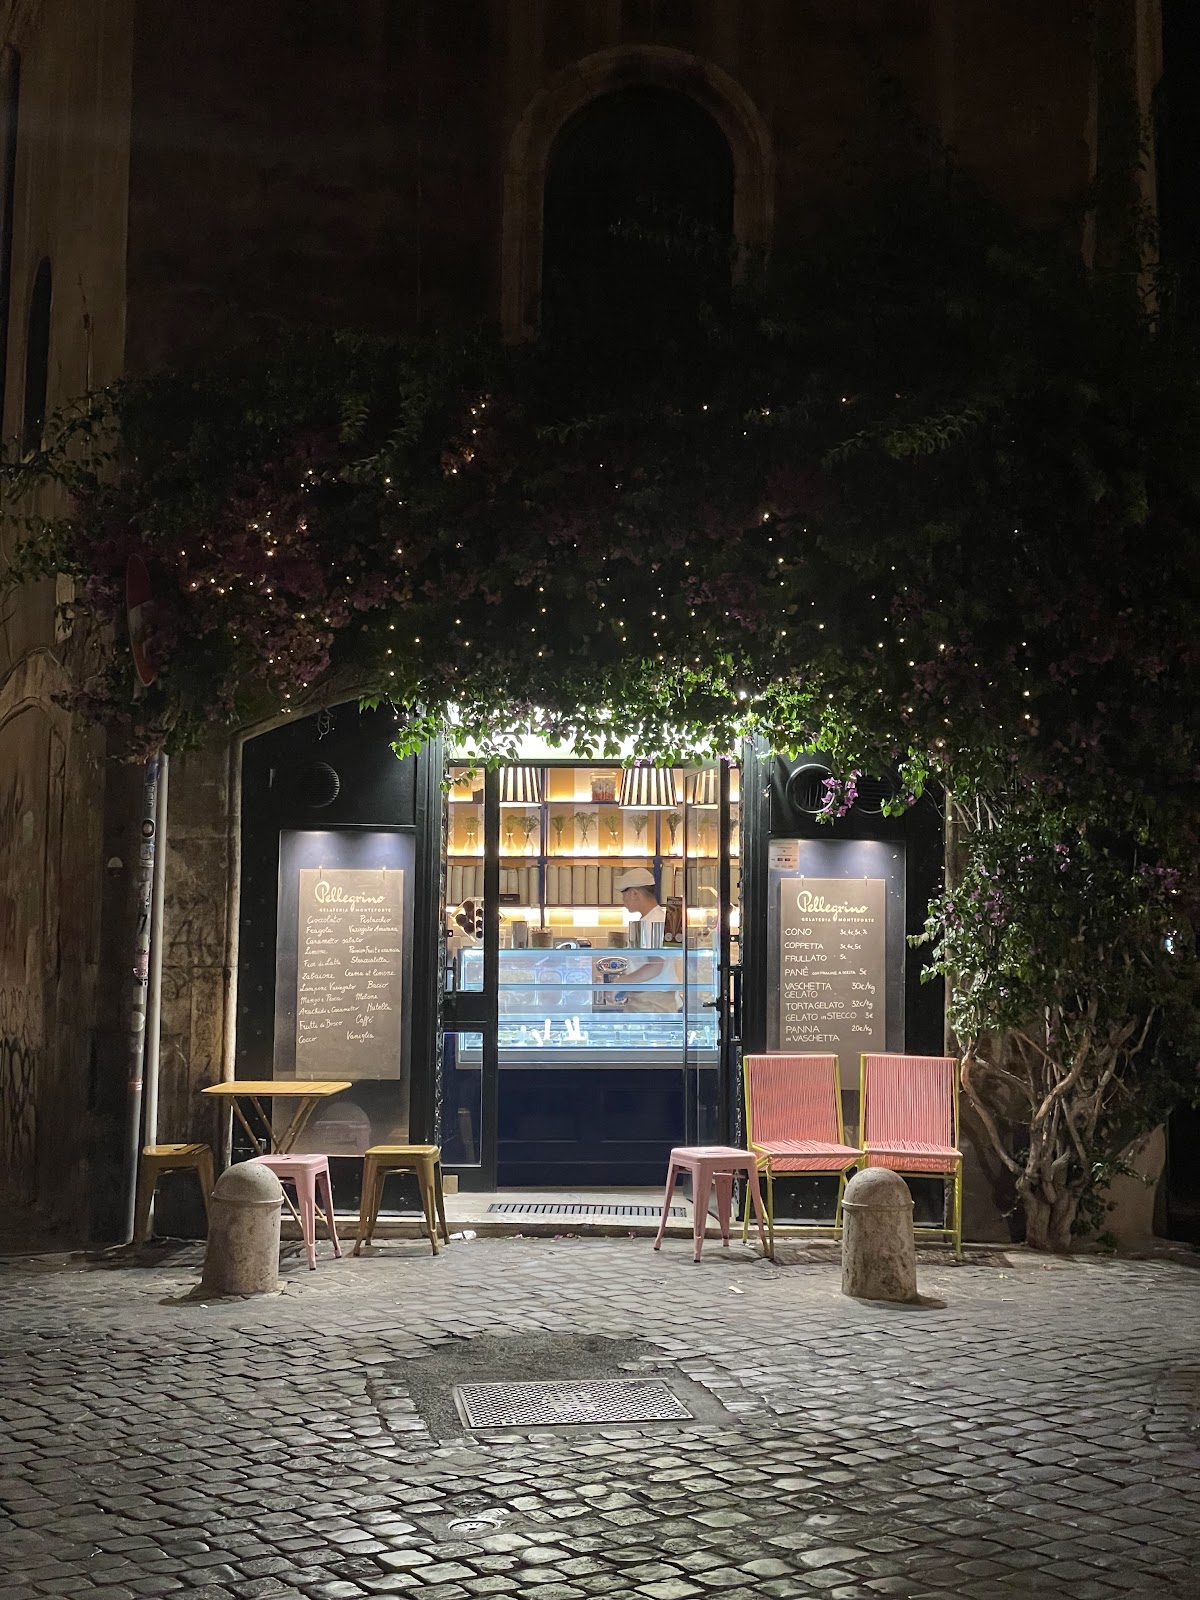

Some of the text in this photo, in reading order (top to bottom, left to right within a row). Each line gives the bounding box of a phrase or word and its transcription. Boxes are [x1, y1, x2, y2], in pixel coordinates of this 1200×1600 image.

[315, 881, 385, 912] Pellegrino
[796, 891, 868, 922] Pellegrino
[307, 915, 342, 924] Cioccolato
[360, 915, 391, 923] Pistacchio
[306, 926, 333, 937] Fragola
[785, 928, 812, 936] CONO
[305, 946, 328, 955] Limone
[784, 942, 824, 950] COPPETTA
[785, 954, 828, 962] FRULLATO
[367, 981, 389, 989] Bacio
[784, 982, 832, 991] VASCHETTA
[784, 991, 818, 999] GELATO
[366, 1002, 392, 1012] Nutella
[786, 1013, 819, 1022] GELATO
[827, 1012, 857, 1020] STECCO
[786, 1025, 820, 1034] PANNA
[298, 1035, 318, 1044] Cocco
[346, 1031, 375, 1043] Vaniglia
[792, 1034, 840, 1042] VASCHETTA
